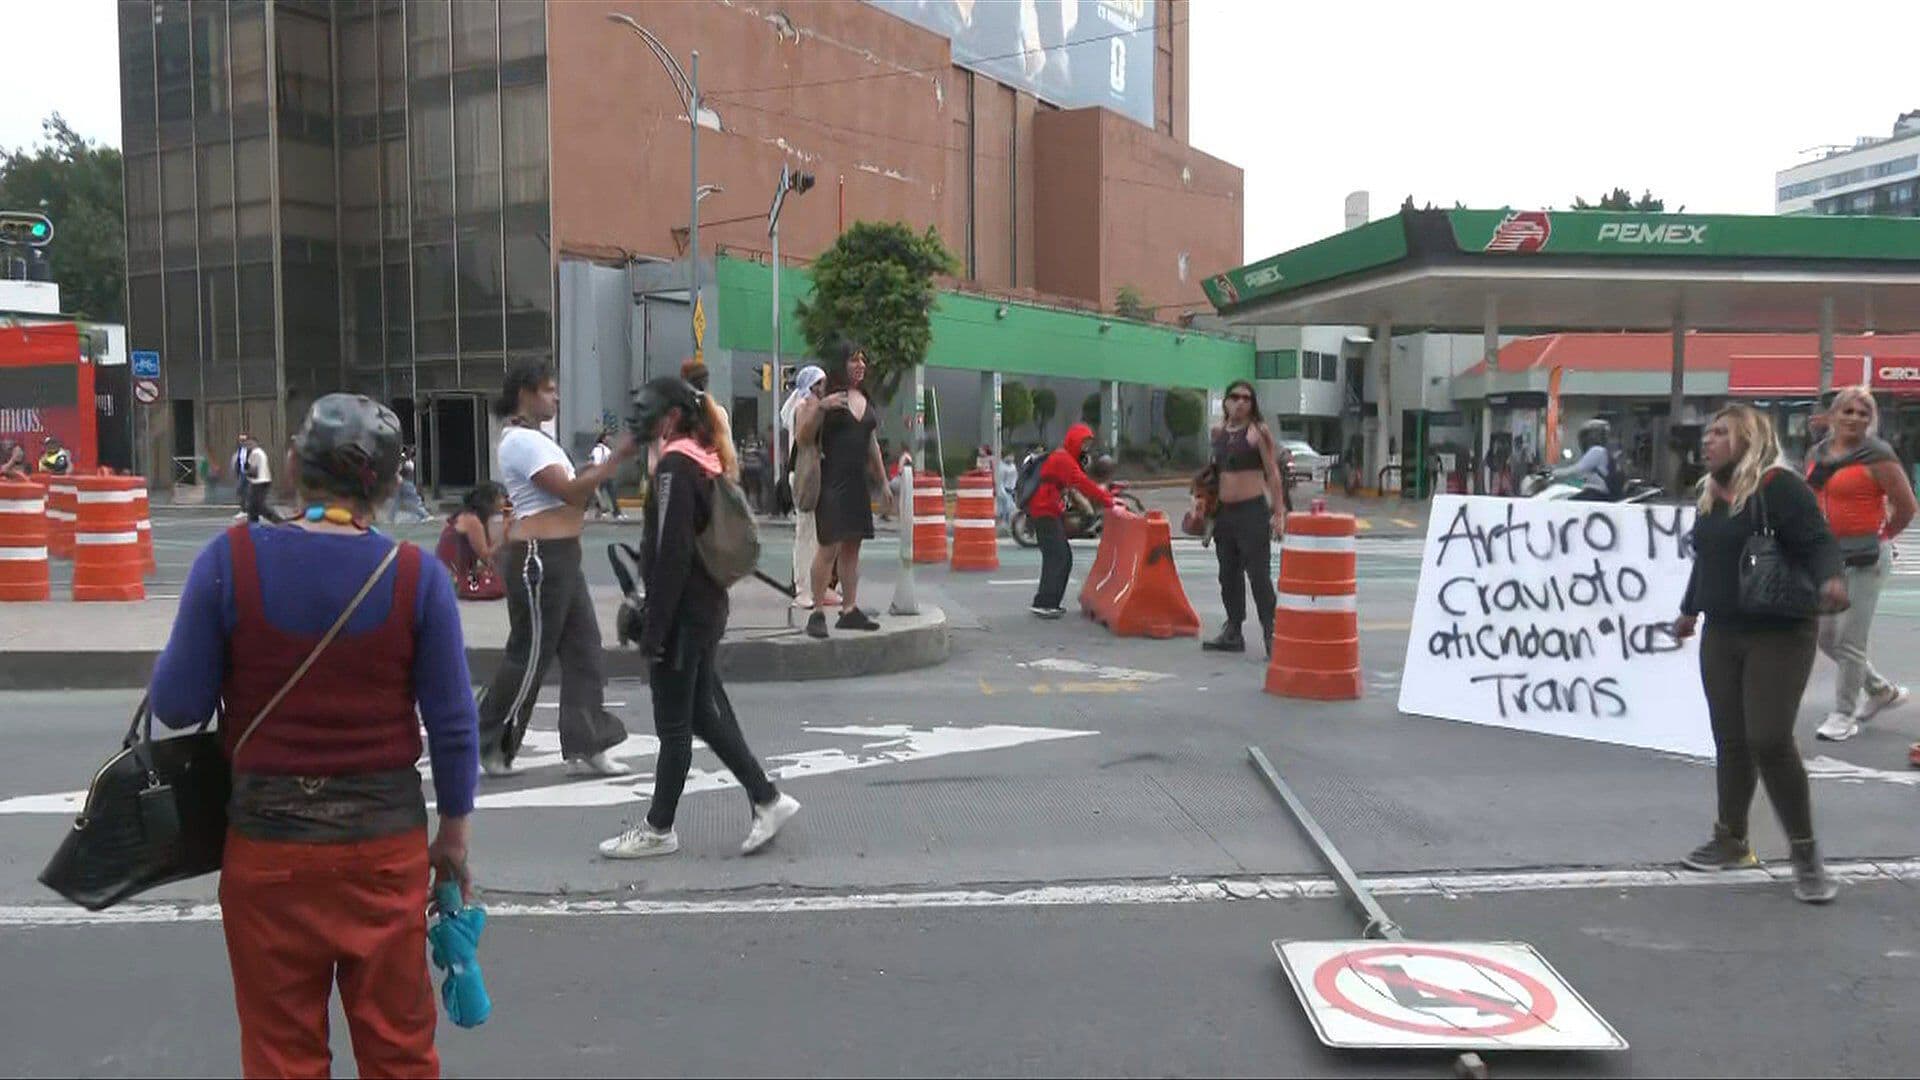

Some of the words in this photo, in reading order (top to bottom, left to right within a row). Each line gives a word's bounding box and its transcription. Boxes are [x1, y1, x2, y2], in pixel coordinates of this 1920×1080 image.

[1597, 223, 1709, 244] PEMEX
[1437, 504, 1616, 566] Arturo
[1438, 558, 1648, 616] Cravioto
[1471, 673, 1628, 718] Trans
